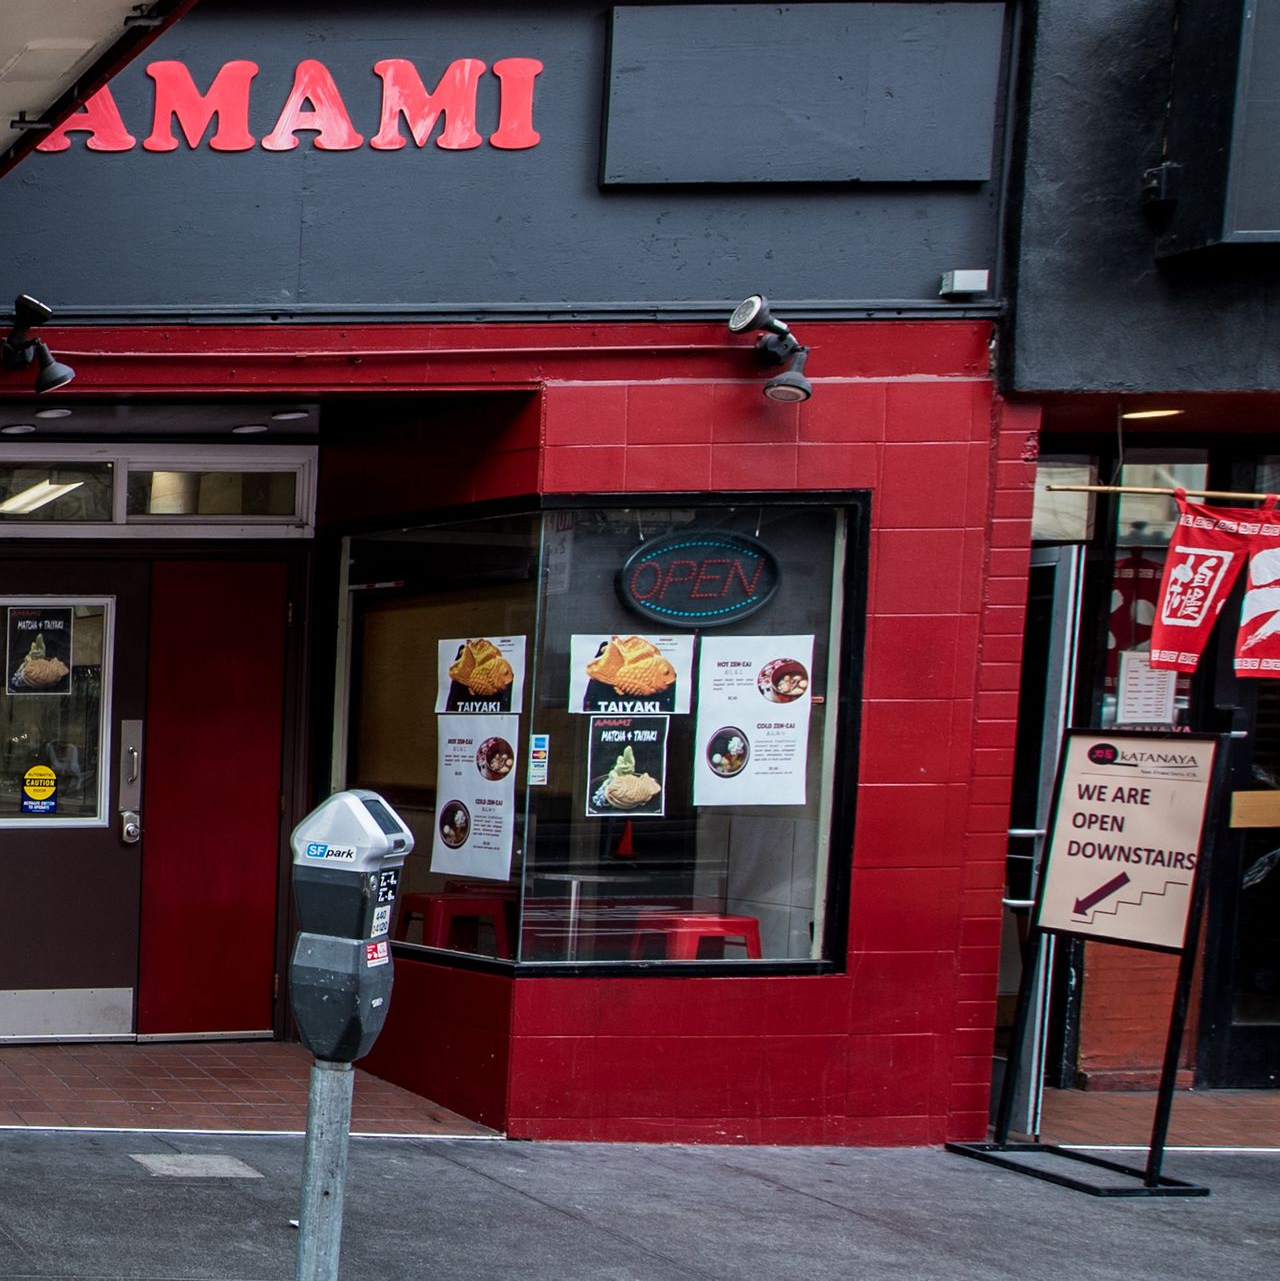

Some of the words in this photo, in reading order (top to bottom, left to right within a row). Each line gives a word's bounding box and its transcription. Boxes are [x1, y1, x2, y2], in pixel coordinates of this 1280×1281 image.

[37, 57, 543, 152] AMAMI
[630, 558, 766, 600] OPEN
[457, 701, 501, 712] TAIYAKI
[598, 701, 660, 712] TAIYAKI
[601, 730, 626, 742] MATCHA
[633, 730, 658, 742] TAIYAKI
[26, 779, 55, 787] CAUTION
[1077, 784, 1108, 802] WE
[1111, 787, 1151, 806] ARE
[1072, 812, 1125, 833] OPEN
[1067, 840, 1197, 870] DOWNSTAIRS
